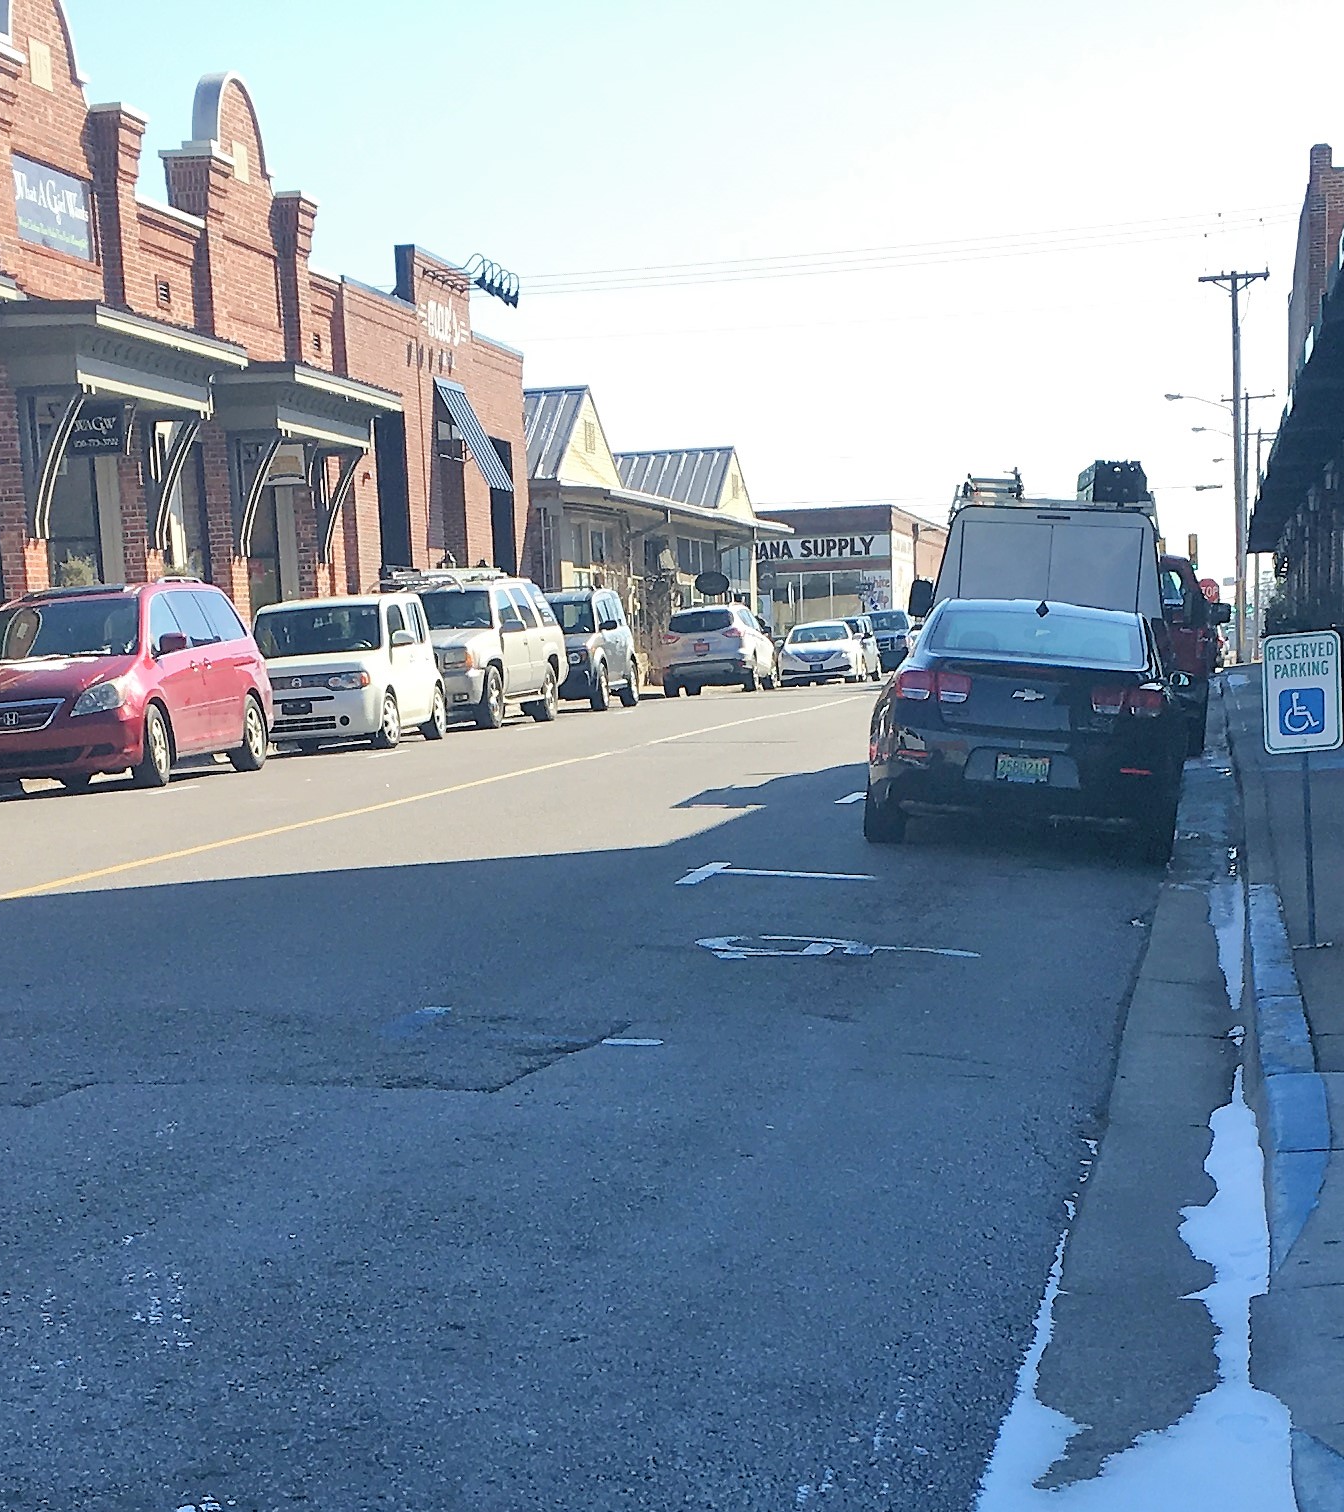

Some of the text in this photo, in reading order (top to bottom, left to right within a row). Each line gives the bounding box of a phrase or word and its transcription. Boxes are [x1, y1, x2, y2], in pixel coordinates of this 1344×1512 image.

[13, 169, 90, 226] What A Girl Wants
[800, 534, 875, 558] SUPPLY
[1201, 586, 1219, 598] TOP
[1268, 641, 1334, 661] RESERVED
[1274, 660, 1329, 679] PARKING
